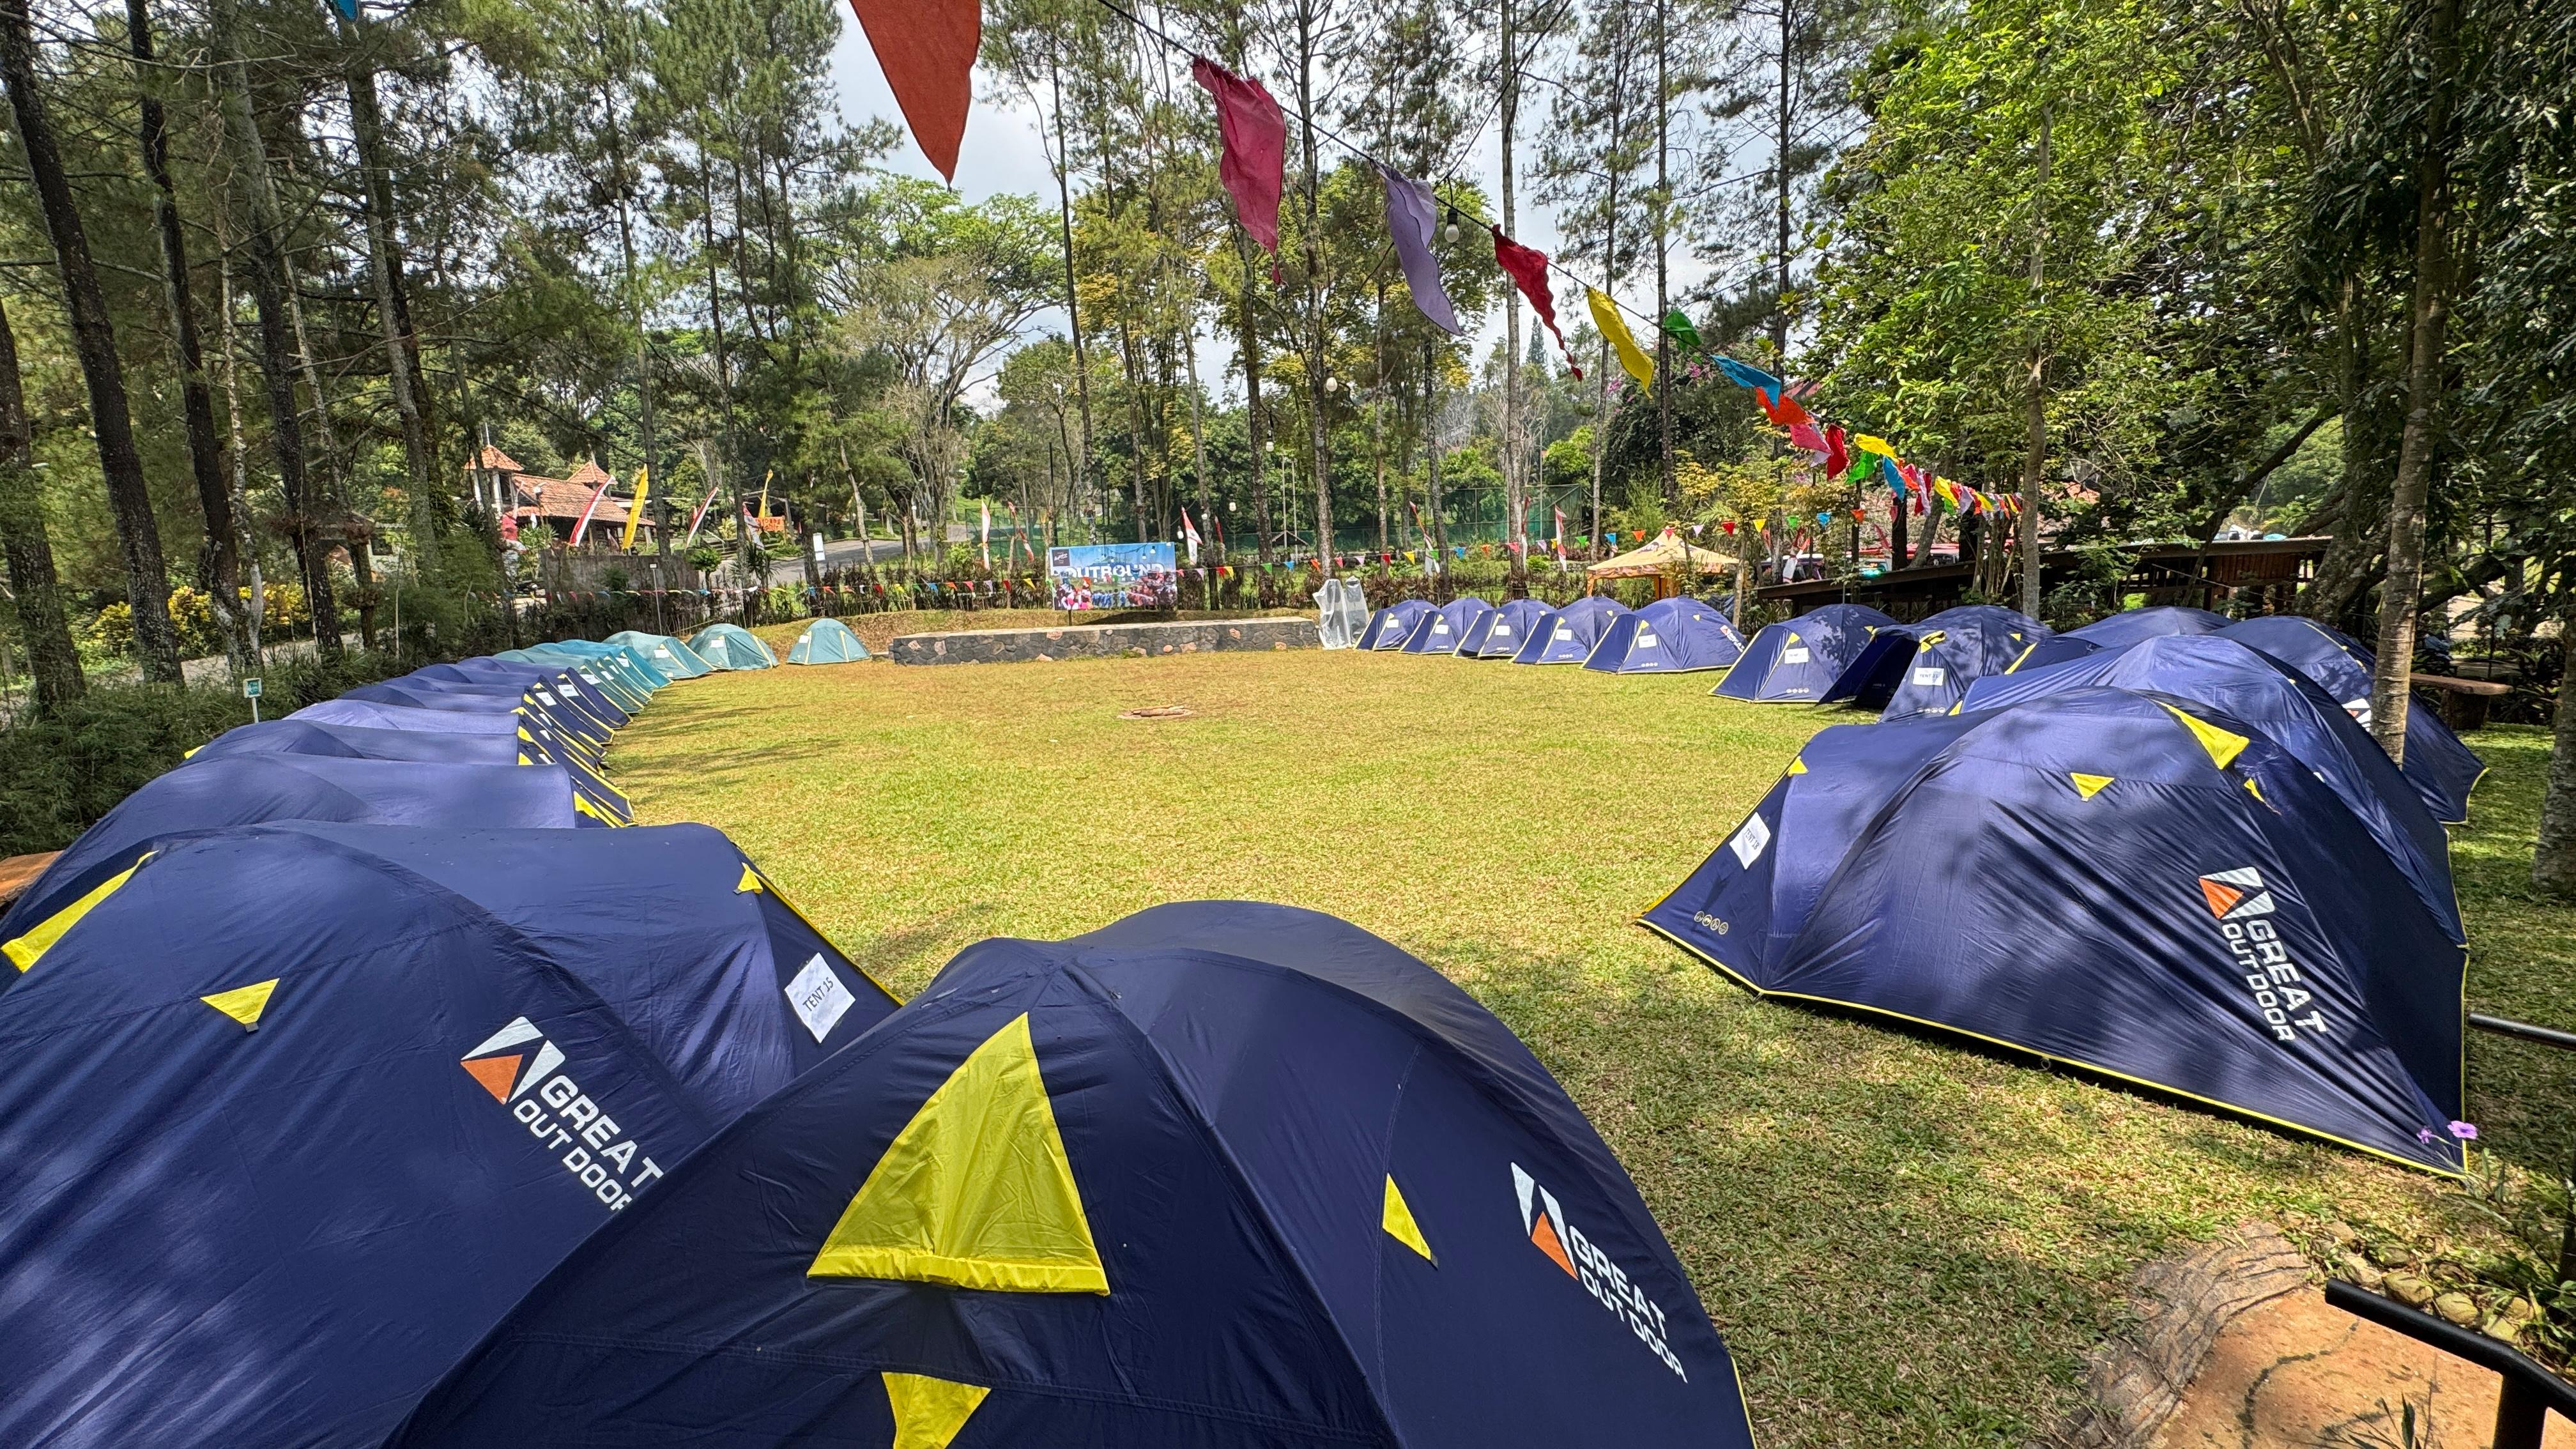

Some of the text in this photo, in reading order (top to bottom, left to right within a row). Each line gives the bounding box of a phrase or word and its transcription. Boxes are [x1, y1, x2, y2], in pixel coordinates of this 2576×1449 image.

[1062, 563, 1165, 580] OUTBOUND
[1744, 828, 1756, 843] TENT
[802, 976, 834, 1012] TENT 15
[2222, 923, 2296, 1041] OUT DOOR
[2246, 919, 2327, 1032] GREAT
[513, 1099, 573, 1149] OUT
[540, 1075, 664, 1188] GREAT
[1569, 1225, 1667, 1340] GREAT
[1579, 1266, 1688, 1384] OUT DOOR
